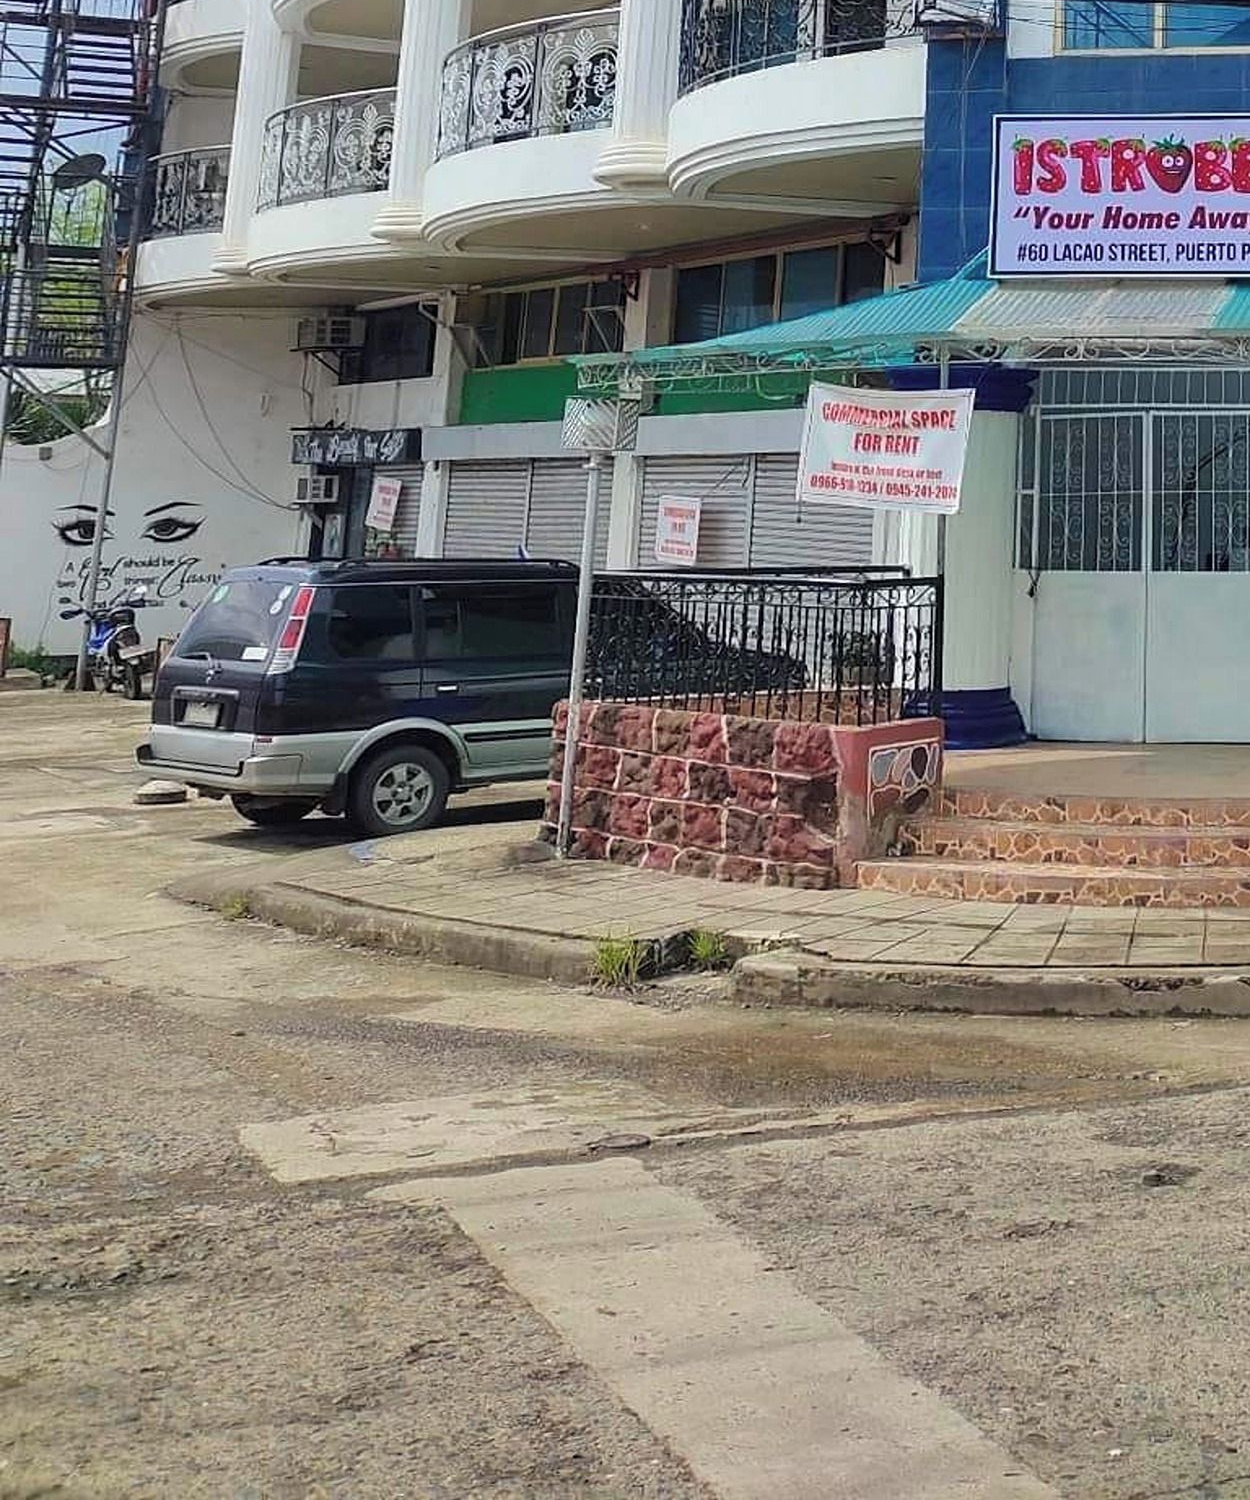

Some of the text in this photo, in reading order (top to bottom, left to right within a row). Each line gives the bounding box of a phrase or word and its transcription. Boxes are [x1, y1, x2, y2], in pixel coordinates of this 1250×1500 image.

[1102, 206, 1180, 229] Home
[1017, 243, 1047, 262] #60
[1053, 243, 1103, 262] LACAO
[1108, 243, 1170, 264] STREET,
[1175, 243, 1236, 262] PUERTO
[822, 401, 956, 430] COMMERCIAL SPACE
[854, 432, 920, 456] FOR RENT
[123, 557, 160, 568] should
